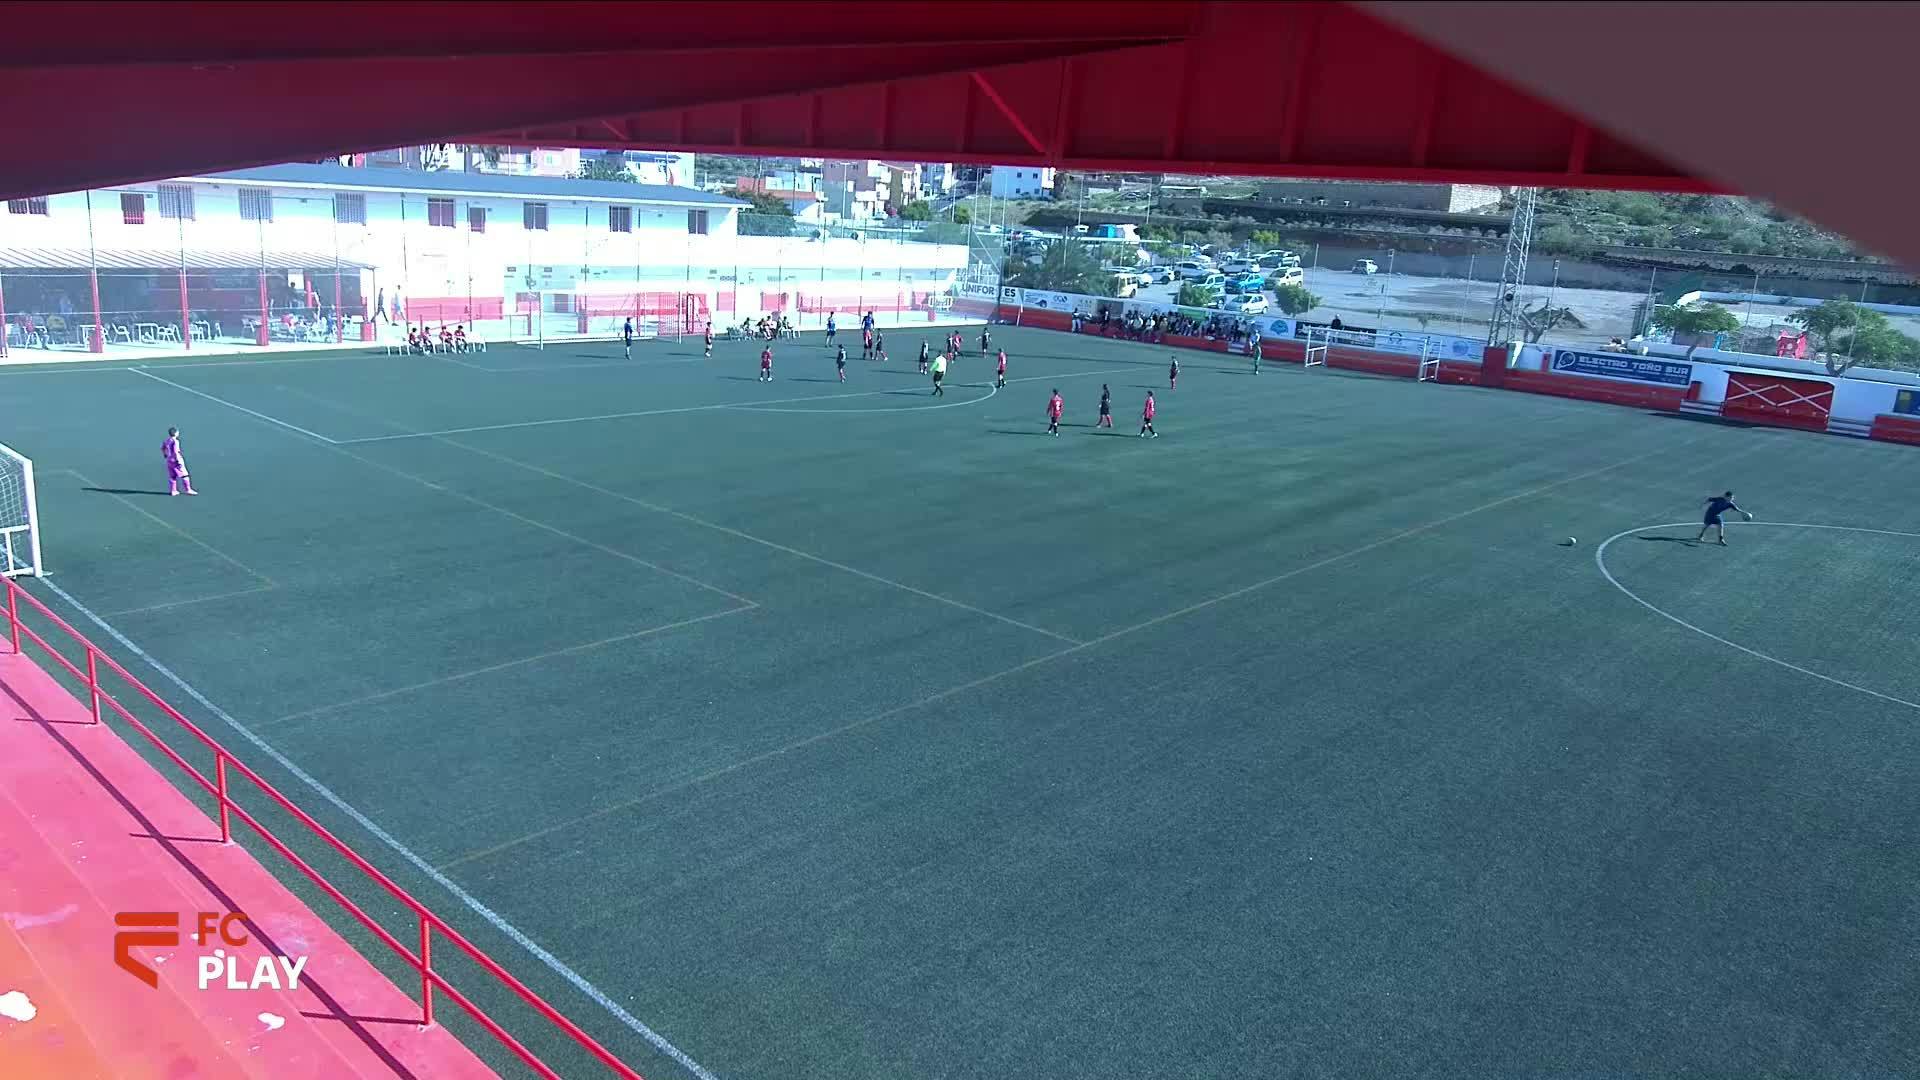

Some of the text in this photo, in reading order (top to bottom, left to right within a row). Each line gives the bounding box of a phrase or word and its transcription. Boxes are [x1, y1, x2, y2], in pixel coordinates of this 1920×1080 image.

[962, 284, 1016, 297] UNIFORES
[1579, 356, 1688, 375] ELECTRO TOÑO SUR
